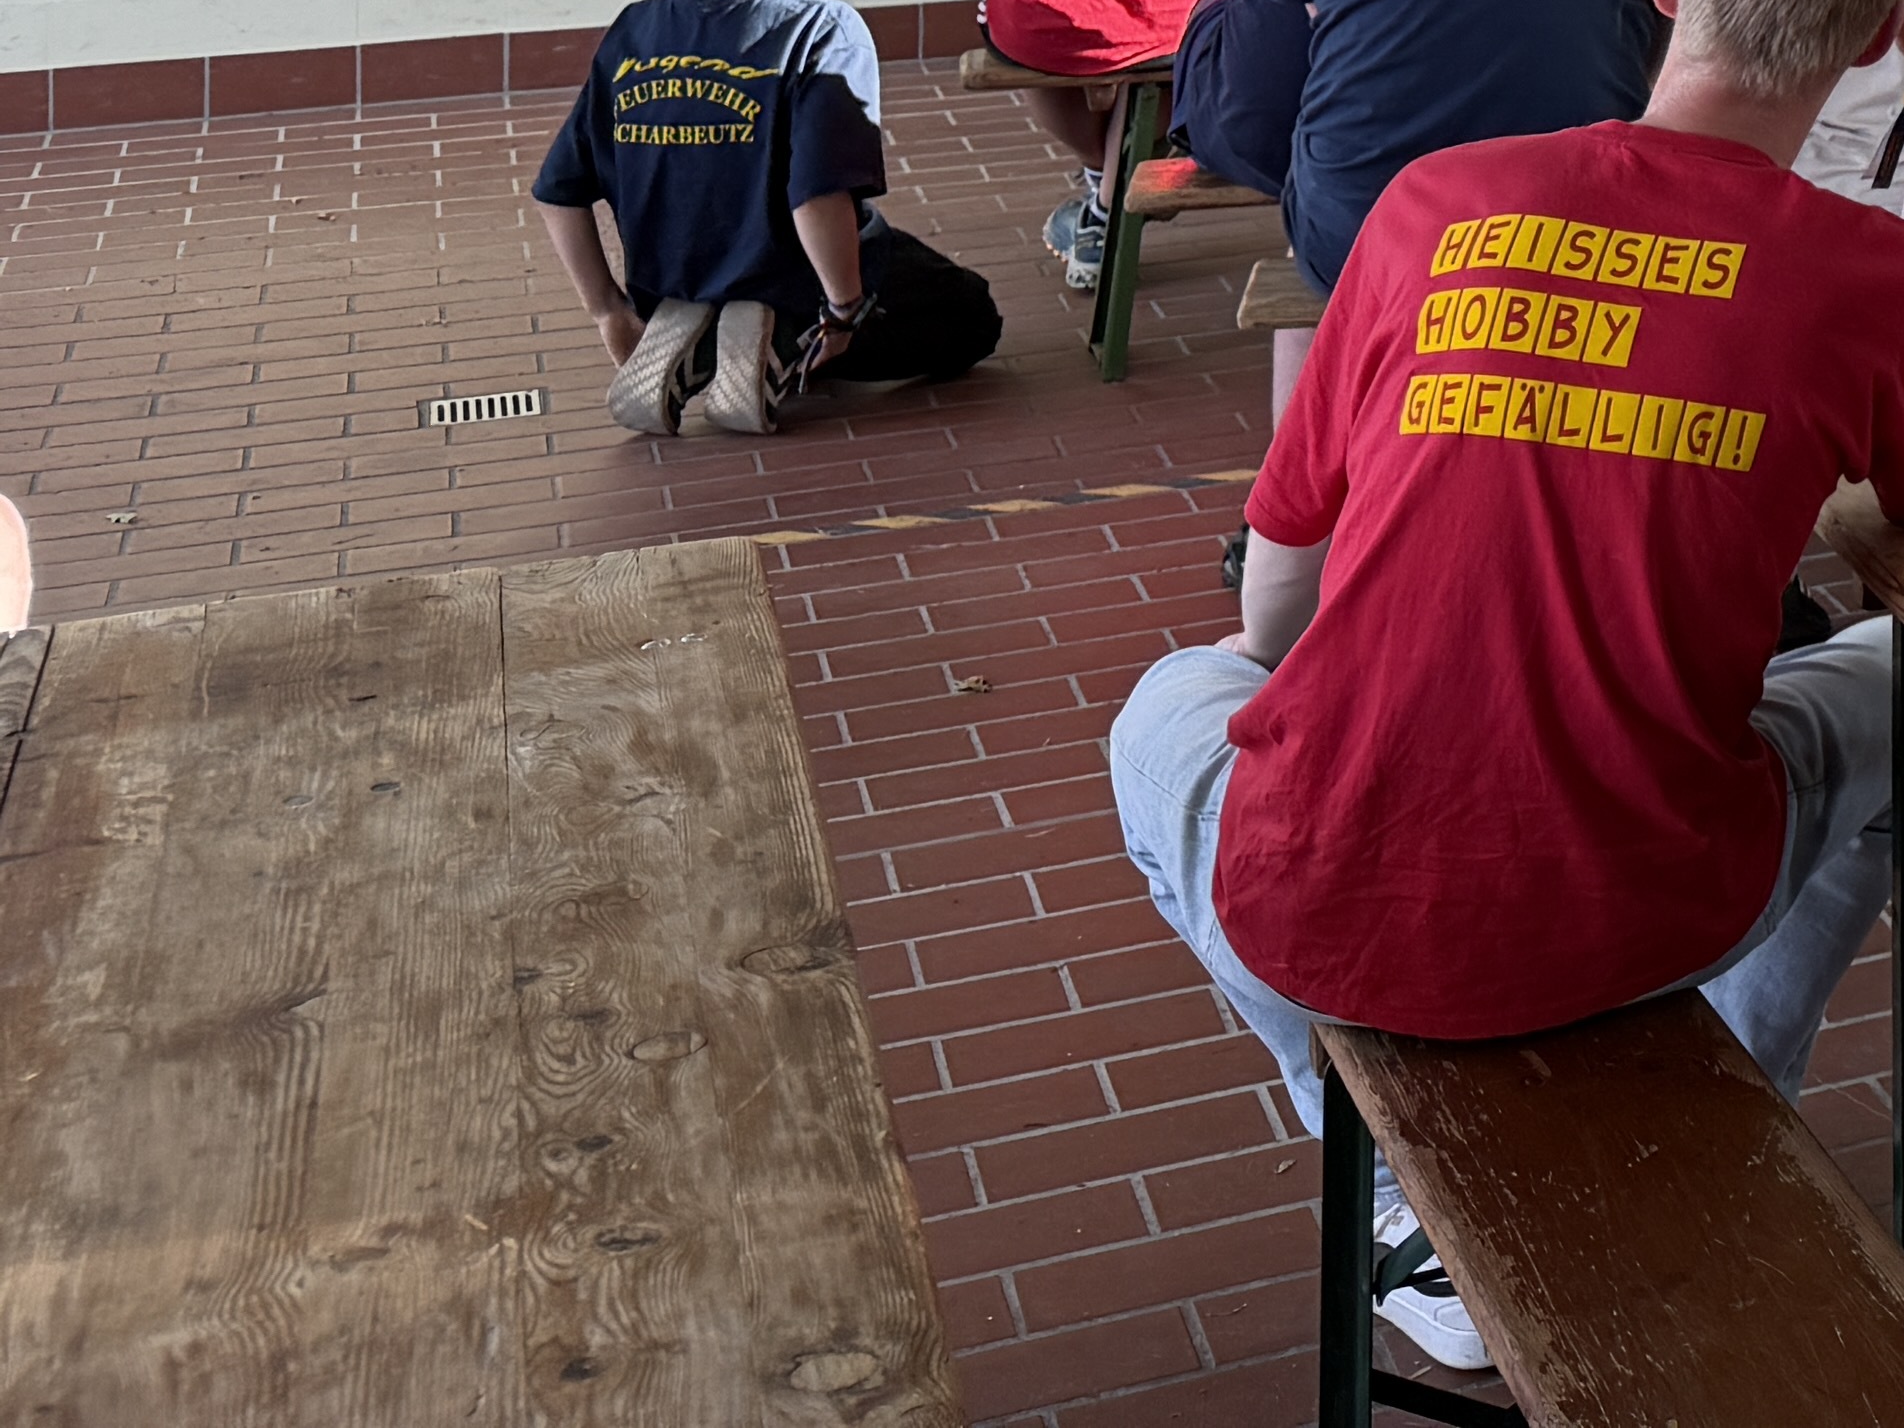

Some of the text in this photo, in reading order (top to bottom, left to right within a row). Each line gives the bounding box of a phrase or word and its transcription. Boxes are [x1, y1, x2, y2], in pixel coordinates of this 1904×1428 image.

[613, 76, 763, 123] EUERWEHR
[1437, 221, 1734, 292] HEISSES
[1422, 292, 1632, 359] HOBBY
[1405, 379, 1750, 467] GEFÄLLIG!
